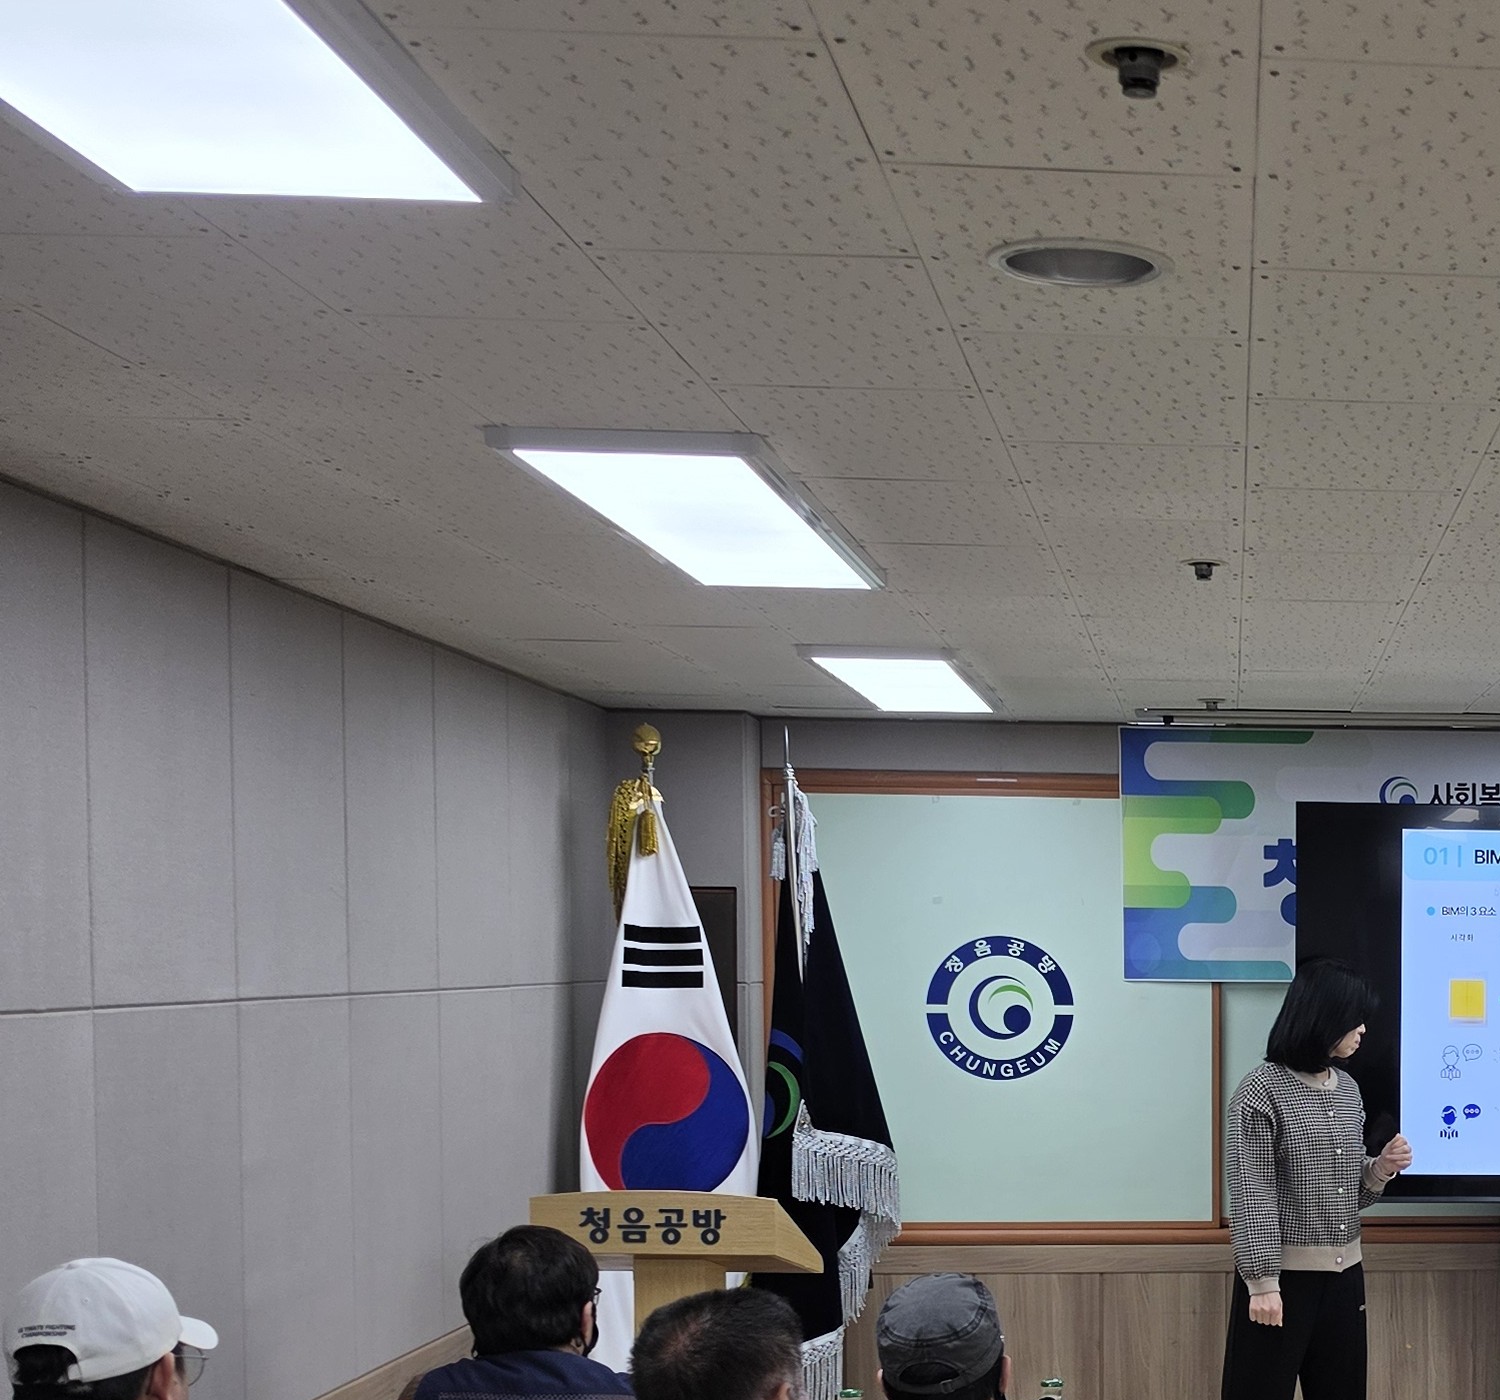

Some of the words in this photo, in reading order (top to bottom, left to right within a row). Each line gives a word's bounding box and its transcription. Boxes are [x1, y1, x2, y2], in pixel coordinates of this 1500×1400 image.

[1441, 905, 1469, 917] BIM의
[1478, 906, 1497, 917] 요소
[945, 939, 1057, 974] 청음공방
[939, 1031, 1062, 1077] CHUNGEUM
[578, 1207, 727, 1245] 청음공방
